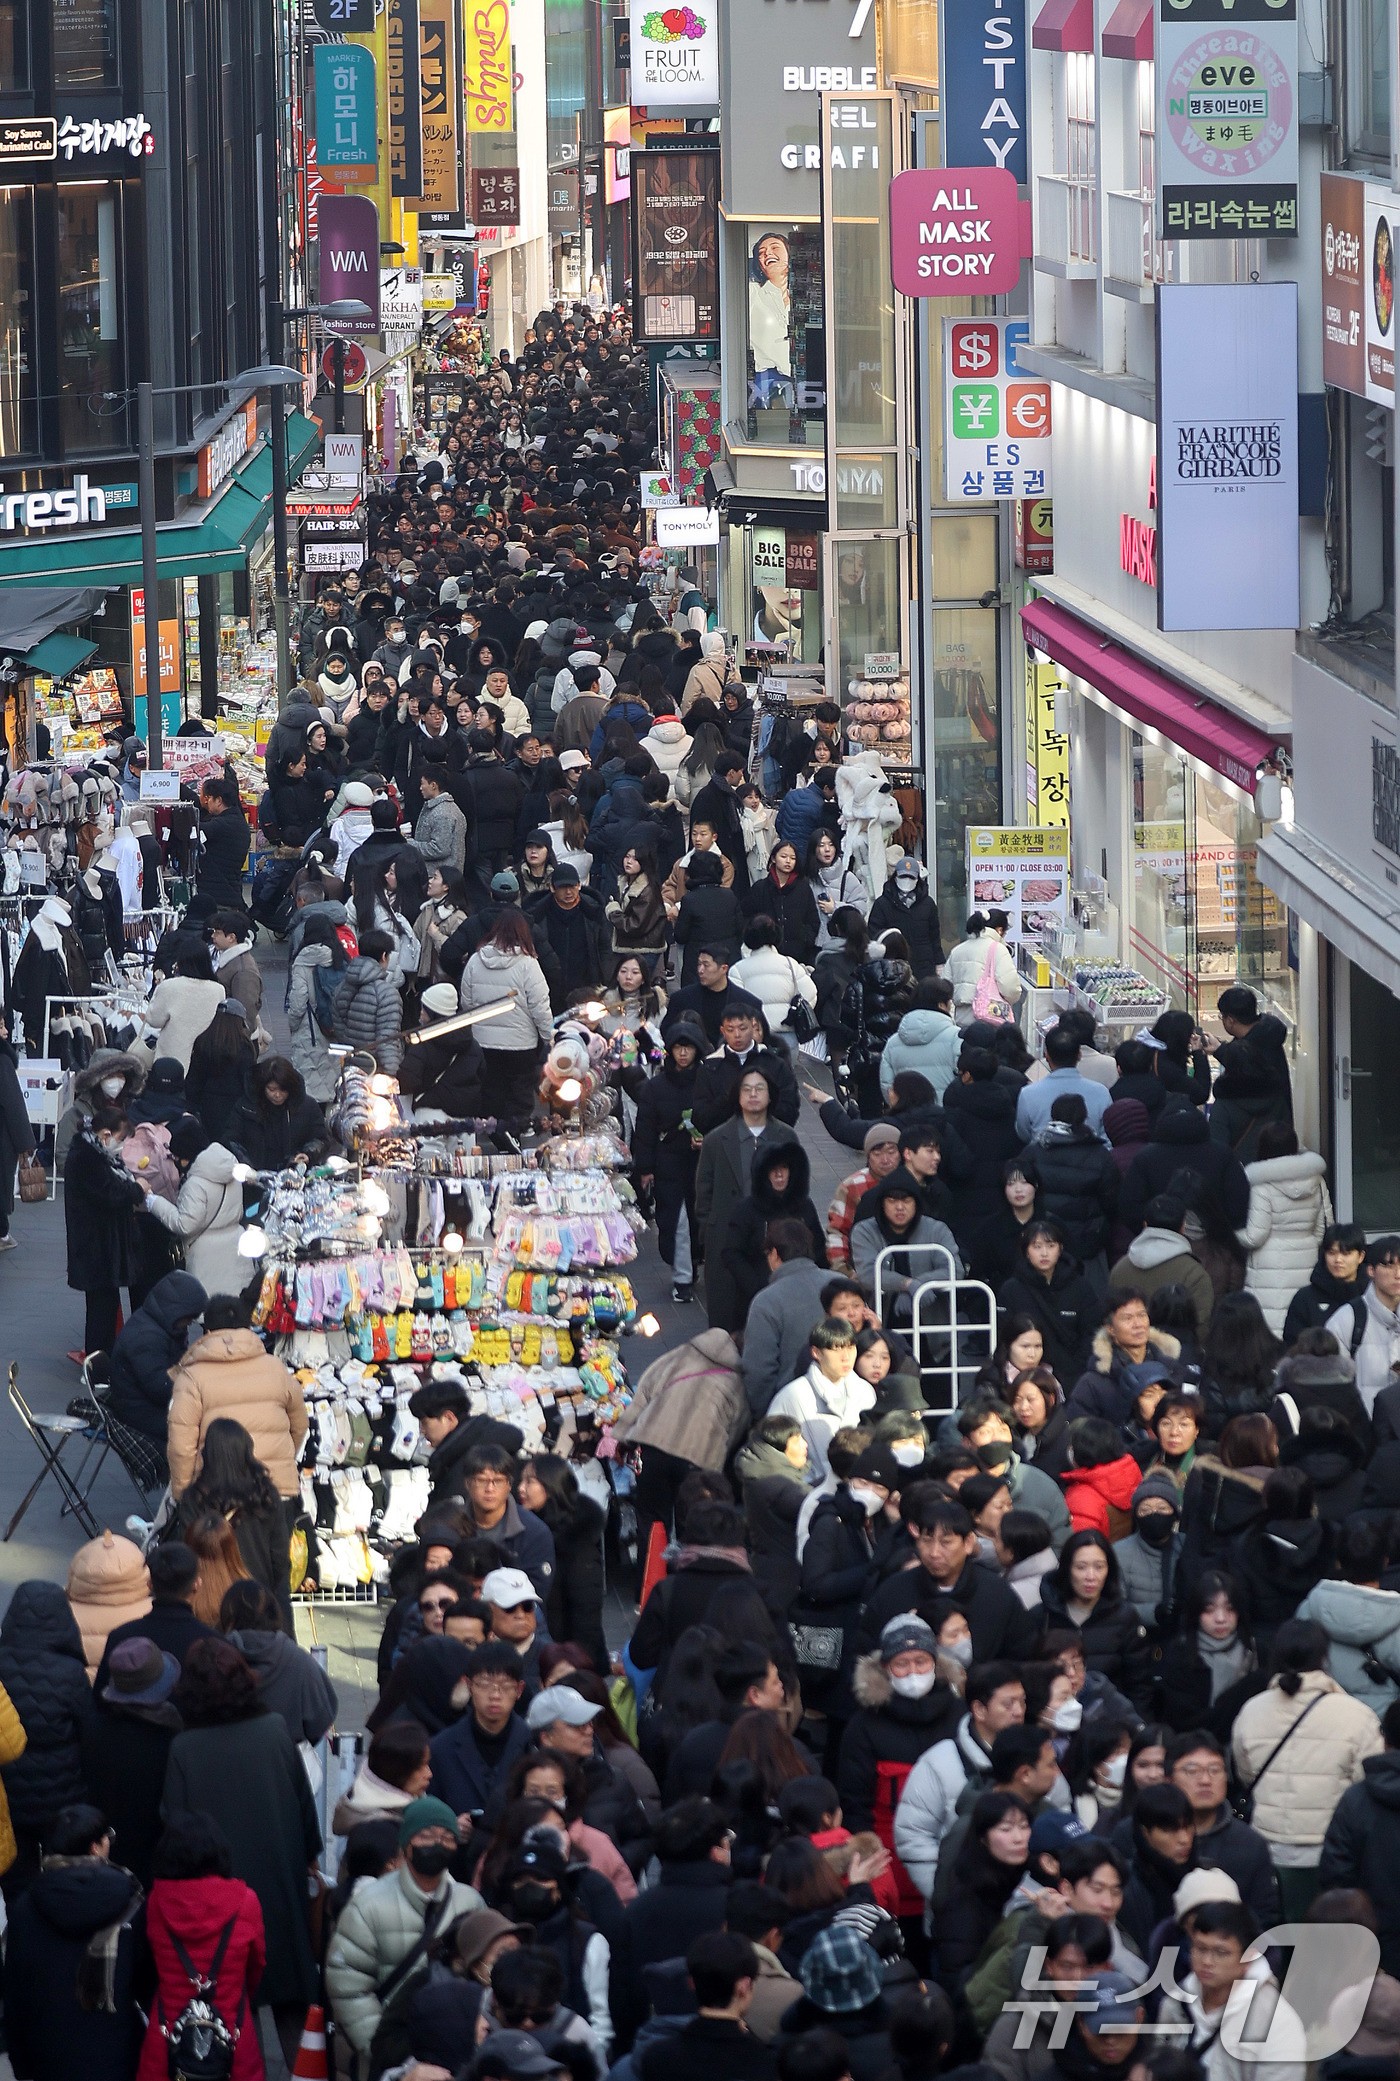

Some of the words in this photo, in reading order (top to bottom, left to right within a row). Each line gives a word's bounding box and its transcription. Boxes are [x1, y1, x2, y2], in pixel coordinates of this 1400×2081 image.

[327, 54, 362, 63] MARKET
[645, 49, 701, 68] FRUIT
[1171, 35, 1287, 88] Threading
[783, 66, 877, 91] BUBBLE
[1201, 65, 1256, 86] eve
[332, 66, 359, 146] 하모니
[1190, 99, 1264, 115] 명동이브아트
[4, 130, 20, 141] Soy
[20, 129, 43, 139] Sauce
[57, 113, 151, 160] 수라게장
[1205, 124, 1254, 142] まゆ毛
[34, 140, 53, 151] Crab
[327, 148, 367, 161] Fresh
[1180, 120, 1285, 173] Waxing
[480, 175, 517, 194] 명동
[480, 196, 517, 213] 교자
[931, 188, 979, 211] ALL
[1168, 199, 1296, 230] 라라속눈썹
[918, 219, 992, 245] MASK
[329, 250, 369, 272] WM
[917, 252, 996, 278] STORY
[405, 273, 420, 283] 5F
[1349, 309, 1360, 347] 2F
[1177, 421, 1281, 443] MARITHÉ
[331, 443, 356, 457] WM
[1177, 459, 1282, 479] GIRBAUD
[961, 470, 1045, 496] 상품권
[0, 474, 106, 530] resh
[105, 488, 131, 504] 명동점
[314, 505, 332, 515] WM
[333, 505, 352, 515] WM
[662, 522, 713, 531] TONYMOLY
[758, 541, 781, 554] BIG
[790, 544, 814, 558] BIG
[1120, 512, 1157, 588] MASK
[754, 554, 785, 568] SALE
[786, 557, 817, 571] SALE
[1026, 557, 1040, 566] Es
[1041, 556, 1053, 567] 환
[945, 643, 965, 653] BAG
[975, 864, 994, 873] OPEN
[1020, 864, 1042, 872] CLOSE
[1043, 864, 1064, 872] 03:00
